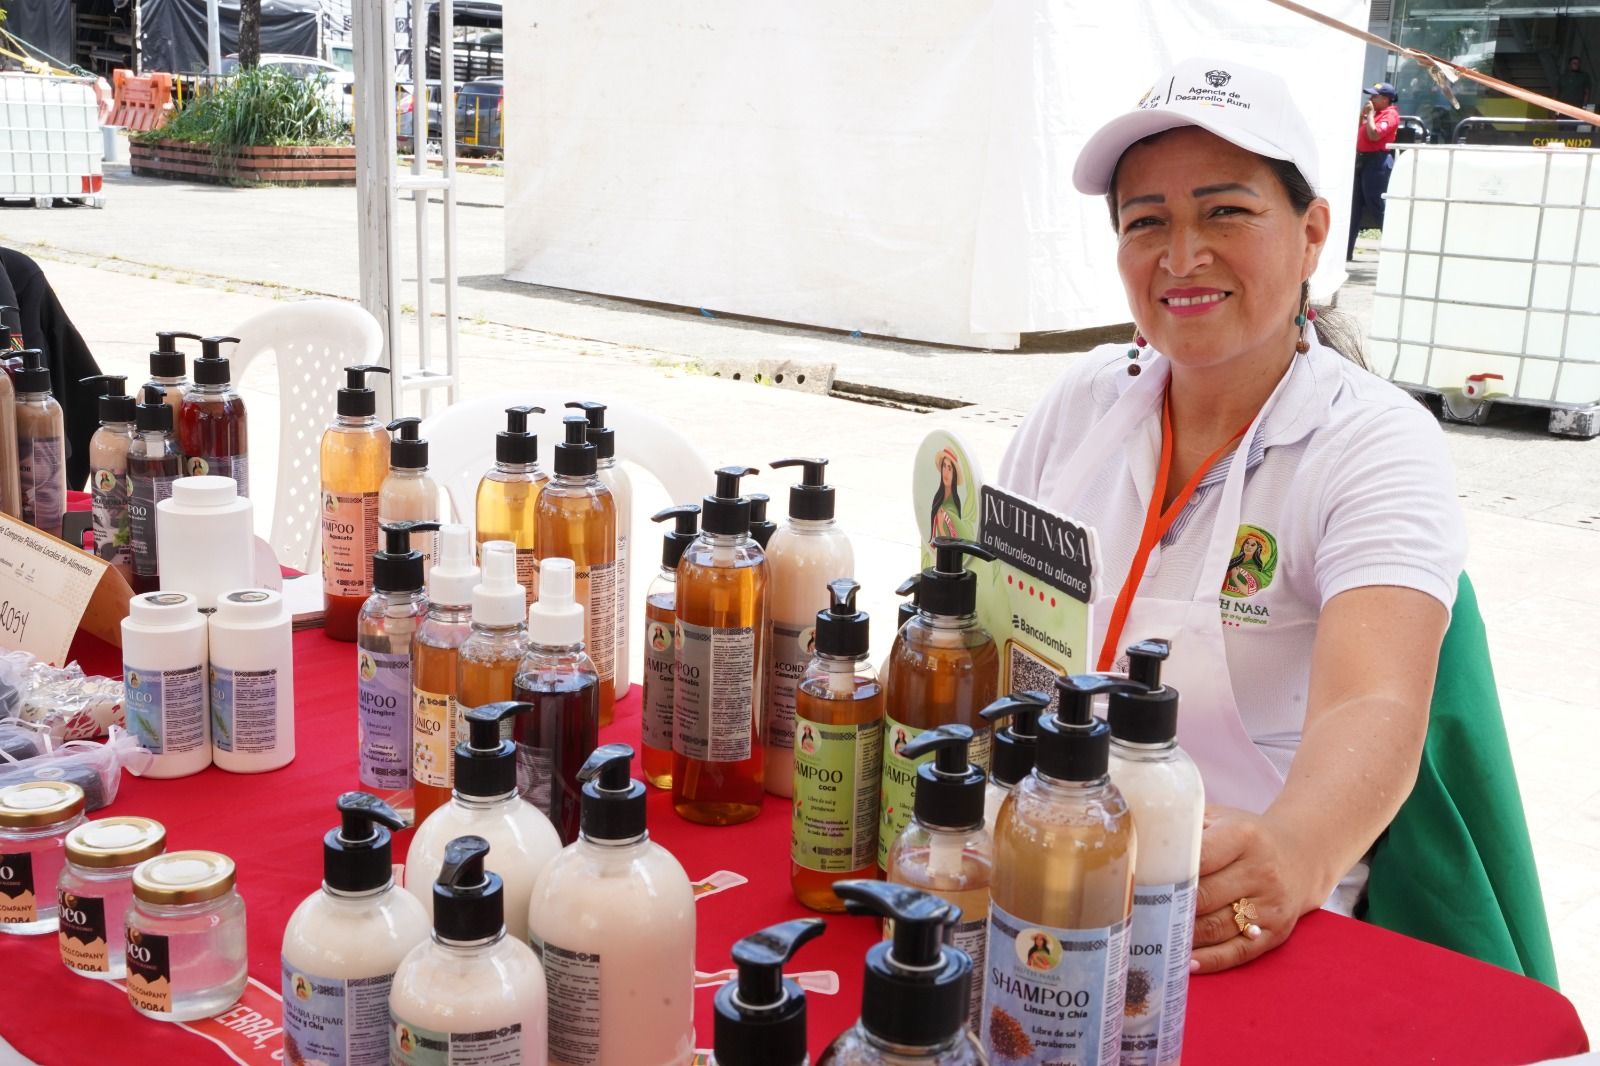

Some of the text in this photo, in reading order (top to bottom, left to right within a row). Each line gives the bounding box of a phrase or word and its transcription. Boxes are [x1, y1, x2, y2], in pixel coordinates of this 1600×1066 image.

[1189, 87, 1241, 99] Agencia de
[1175, 95, 1251, 109] Desarrollo Rural
[984, 493, 1087, 567] JXUTH NASA
[4, 527, 24, 542] Compras
[43, 546, 61, 560] Locales
[60, 555, 67, 564] de
[67, 558, 92, 576] Alimentos
[984, 531, 1087, 594] La Naturaleza a tu alcance
[1234, 602, 1270, 616] NASA
[1020, 618, 1072, 658] Bancolombia
[992, 967, 1089, 1008] SHAMPOO
[140, 1000, 165, 1012] 0084
[1024, 1003, 1088, 1020] Linaza y Chía
[312, 1014, 344, 1026] PEINAR
[1032, 1025, 1084, 1039] Libre de sal y
[1035, 1040, 1077, 1049] parabenos
